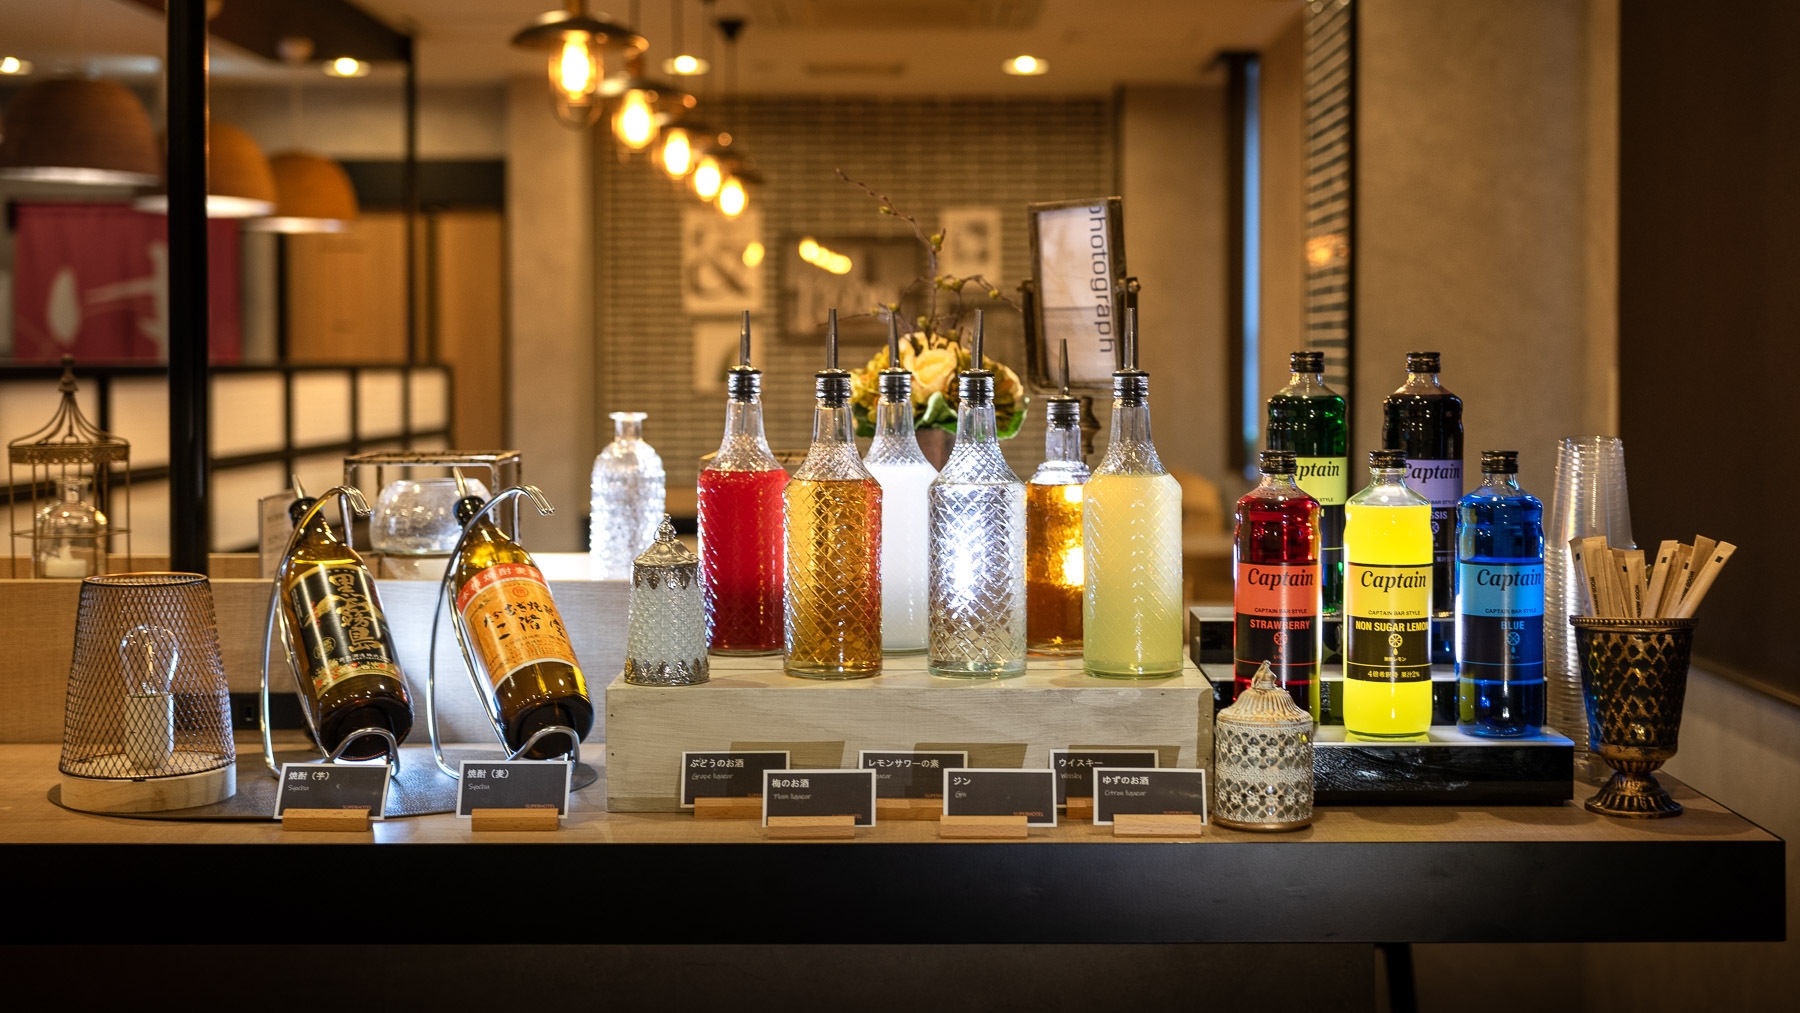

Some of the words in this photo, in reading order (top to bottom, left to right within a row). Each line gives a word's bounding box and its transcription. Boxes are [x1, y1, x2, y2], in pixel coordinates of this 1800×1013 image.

[1295, 461, 1340, 481] ptain
[1430, 510, 1448, 520] SSIS
[1248, 568, 1314, 590] Captain
[1361, 570, 1426, 592] Captain
[1477, 568, 1542, 591] Captain
[1250, 619, 1310, 630] STRAWBERRY
[1355, 620, 1372, 631] NON
[1374, 622, 1405, 632] SUGAR
[1501, 621, 1525, 630] BLUE
[690, 758, 744, 768] ぶどうのお酒
[868, 759, 939, 768] レモンサワーの素
[1059, 759, 1104, 767] ウイスキー
[772, 778, 810, 788] 梅のお酒
[954, 777, 971, 785] ジン
[1102, 776, 1149, 785] ゆずのお酒
